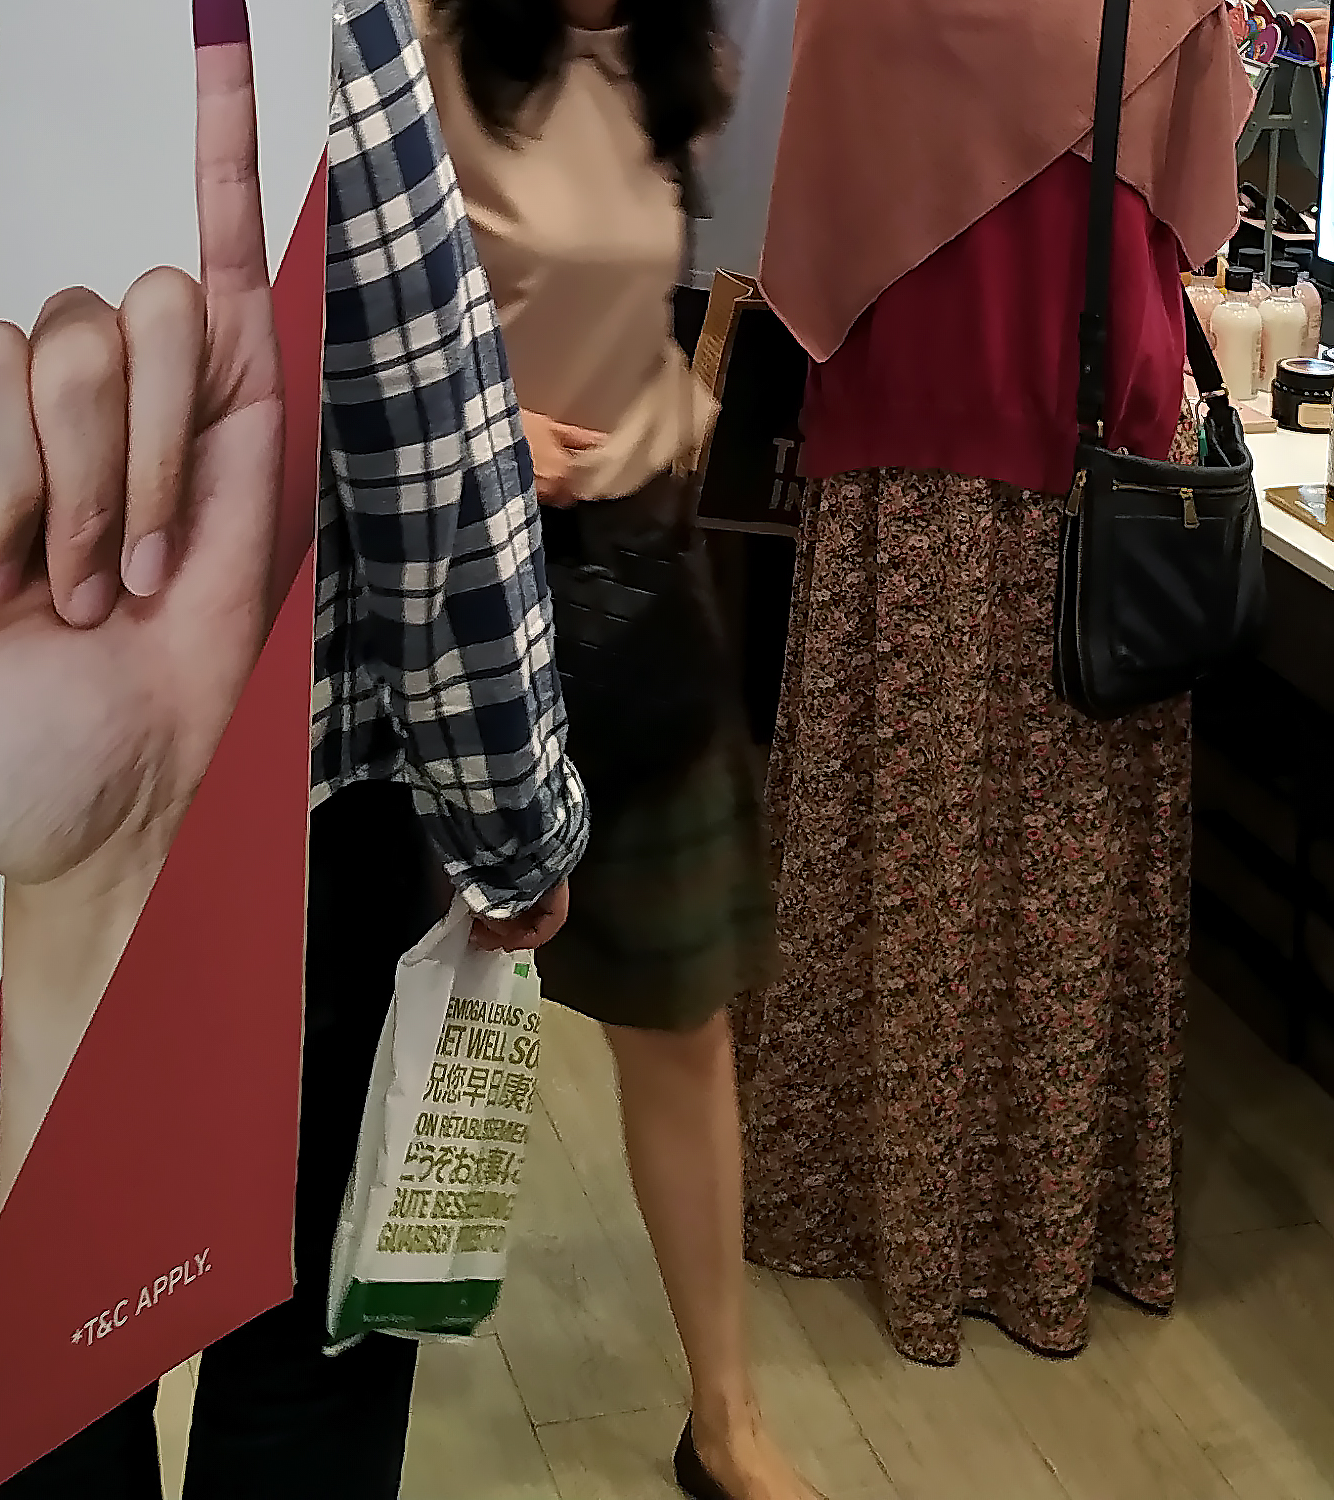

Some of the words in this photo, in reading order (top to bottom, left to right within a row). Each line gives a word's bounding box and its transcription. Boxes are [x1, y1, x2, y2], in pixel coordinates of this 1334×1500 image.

[446, 996, 487, 1023] EMOGA
[466, 1026, 507, 1062] WELL
[134, 1247, 213, 1316] APPLY.
